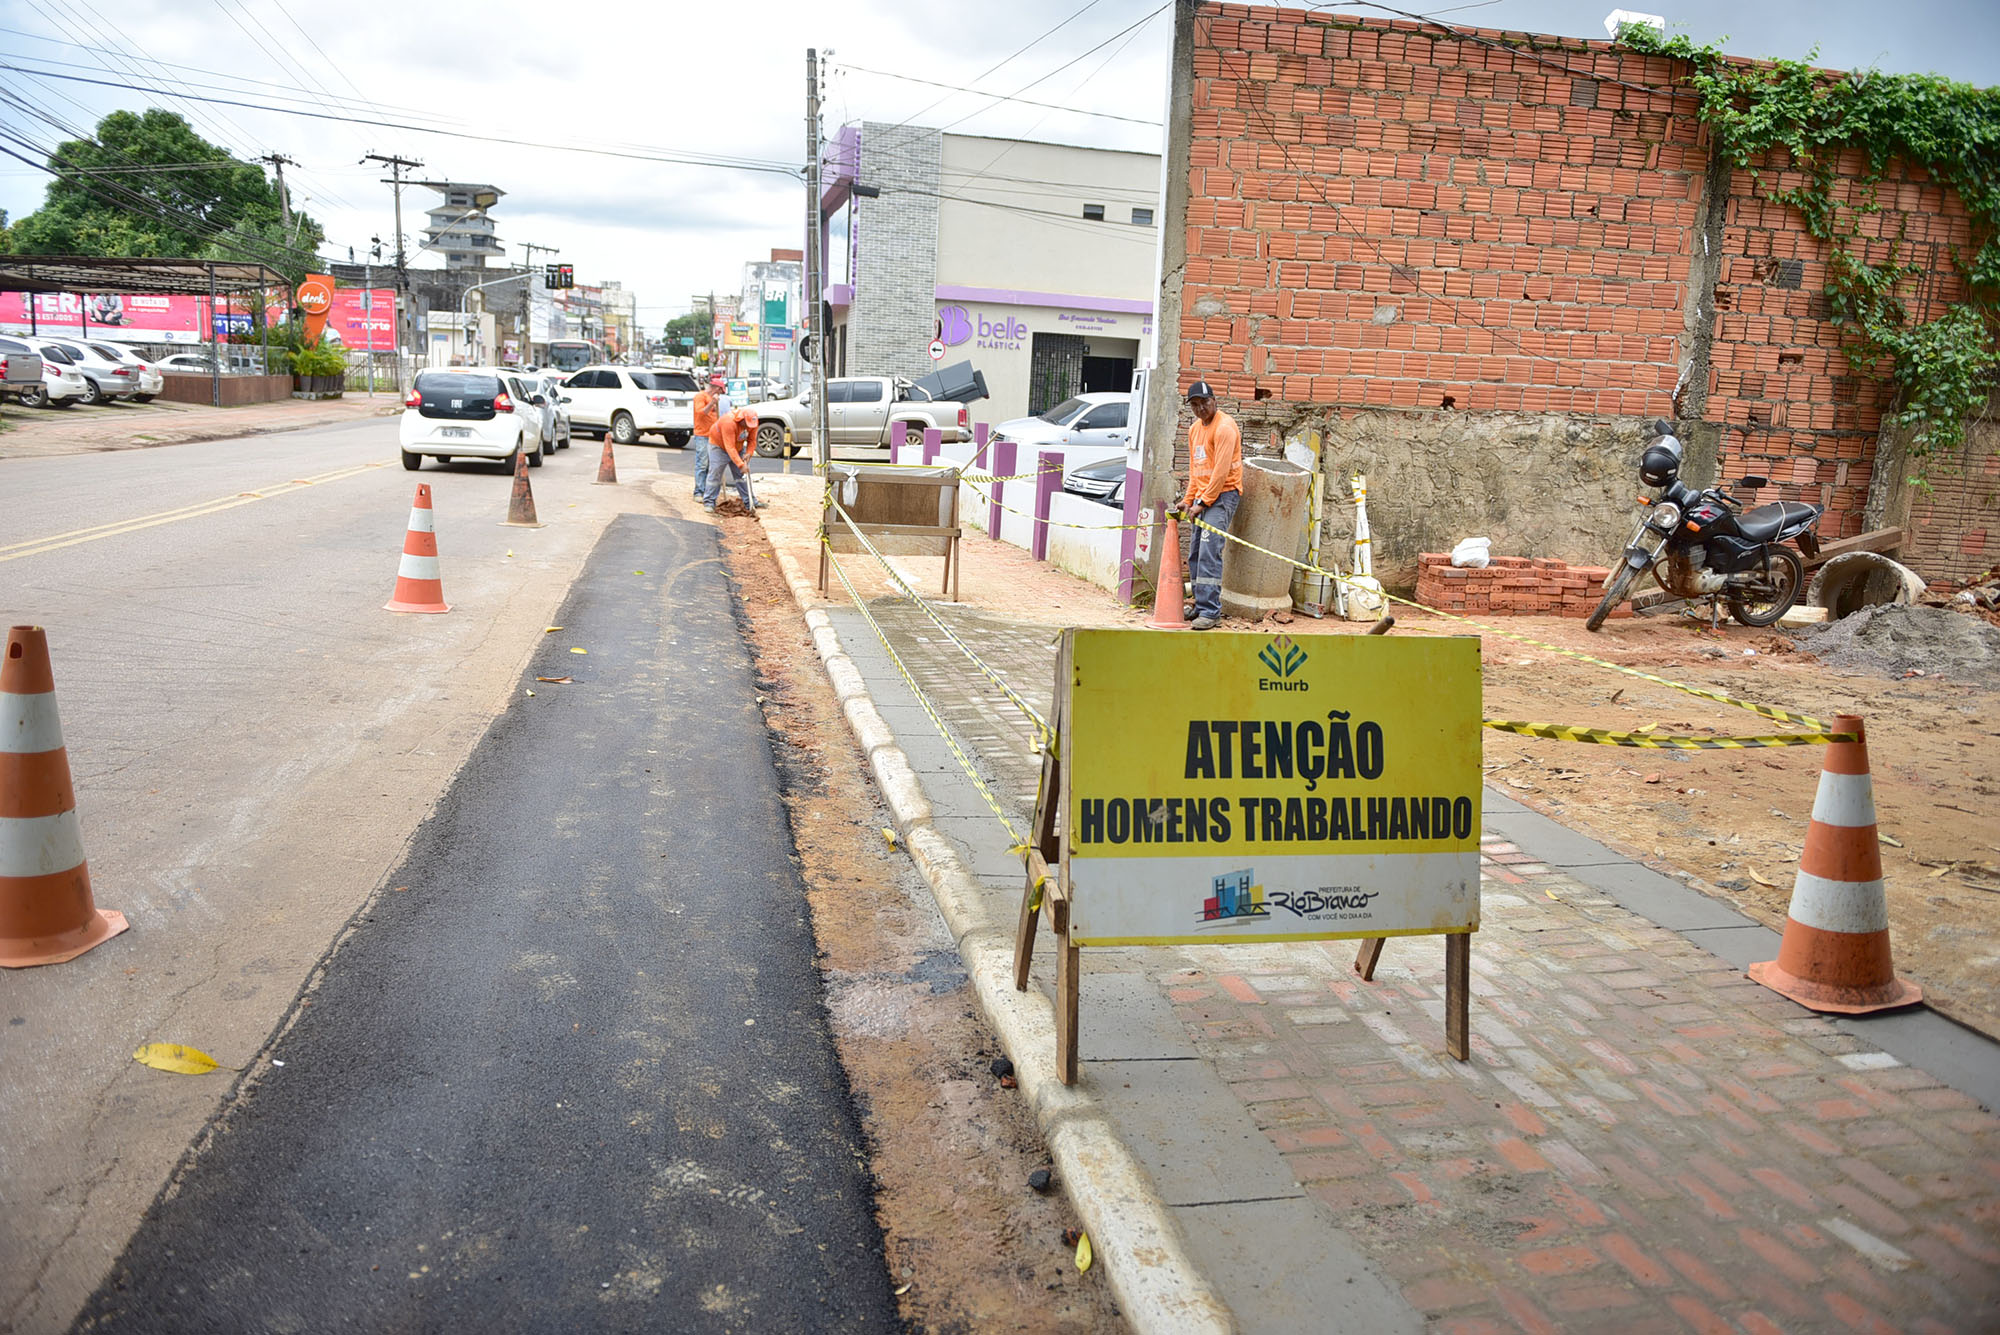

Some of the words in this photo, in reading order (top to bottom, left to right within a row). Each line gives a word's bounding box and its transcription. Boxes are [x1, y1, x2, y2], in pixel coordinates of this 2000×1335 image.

[346, 321, 391, 331] uninorte
[978, 312, 1027, 340] belle
[976, 338, 1021, 351] PLÁSTICA
[1259, 678, 1310, 692] Emurb
[1184, 710, 1384, 792] ATENÇÃO
[1080, 796, 1232, 844] HOMENS
[1239, 795, 1473, 842] TRABALHANDO
[1322, 912, 1338, 920] VOCÊ
